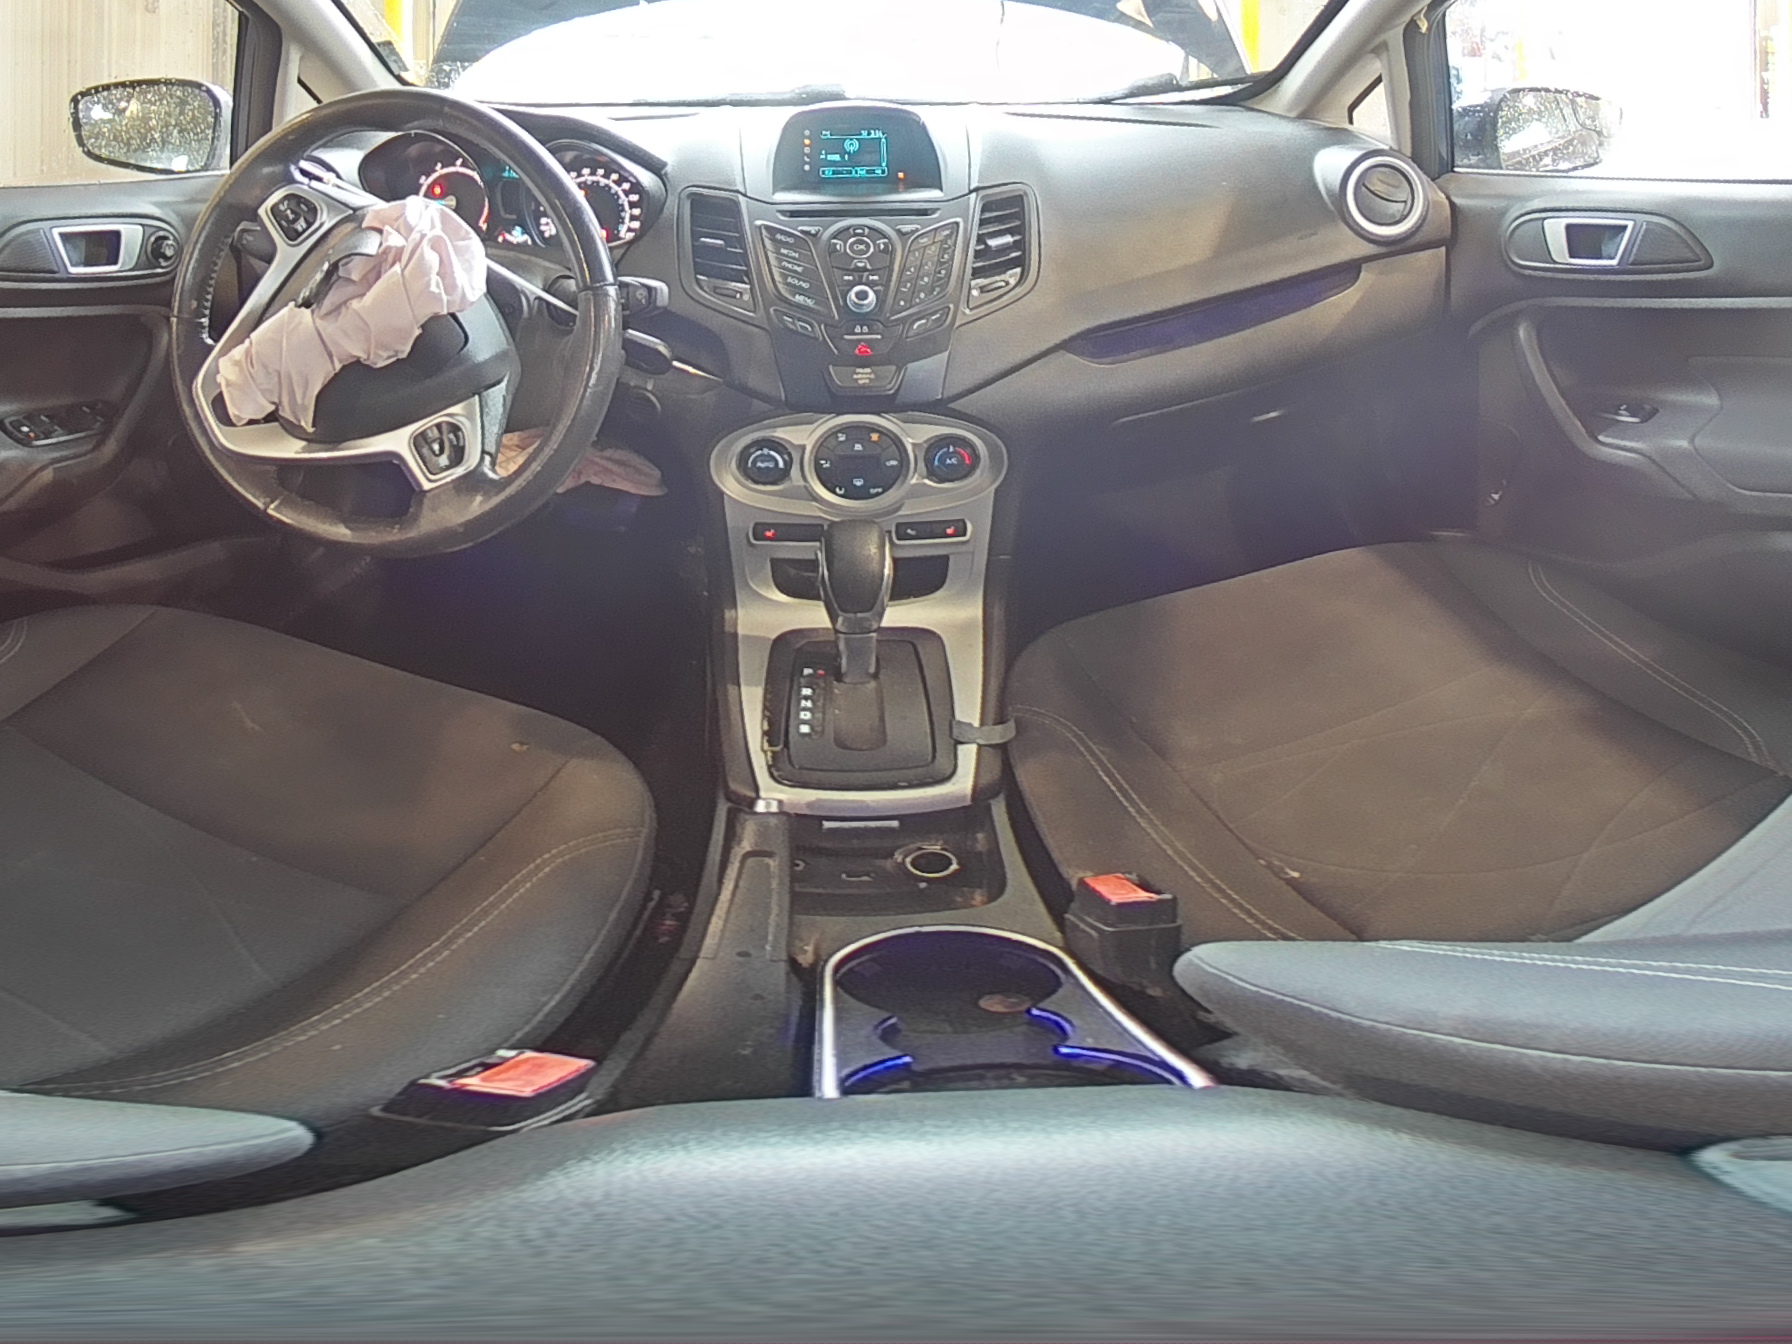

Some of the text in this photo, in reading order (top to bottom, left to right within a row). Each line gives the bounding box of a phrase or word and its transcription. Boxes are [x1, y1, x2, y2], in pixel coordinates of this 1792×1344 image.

[775, 233, 795, 244] RADIO
[853, 243, 867, 251] OK
[780, 248, 799, 258] MEDIA
[781, 261, 804, 273] PHONE
[786, 276, 811, 289] SOUND
[794, 294, 816, 307] MENU
[803, 667, 814, 676] P
[801, 687, 813, 696] R
[800, 699, 813, 708] N
[799, 711, 812, 720] D
